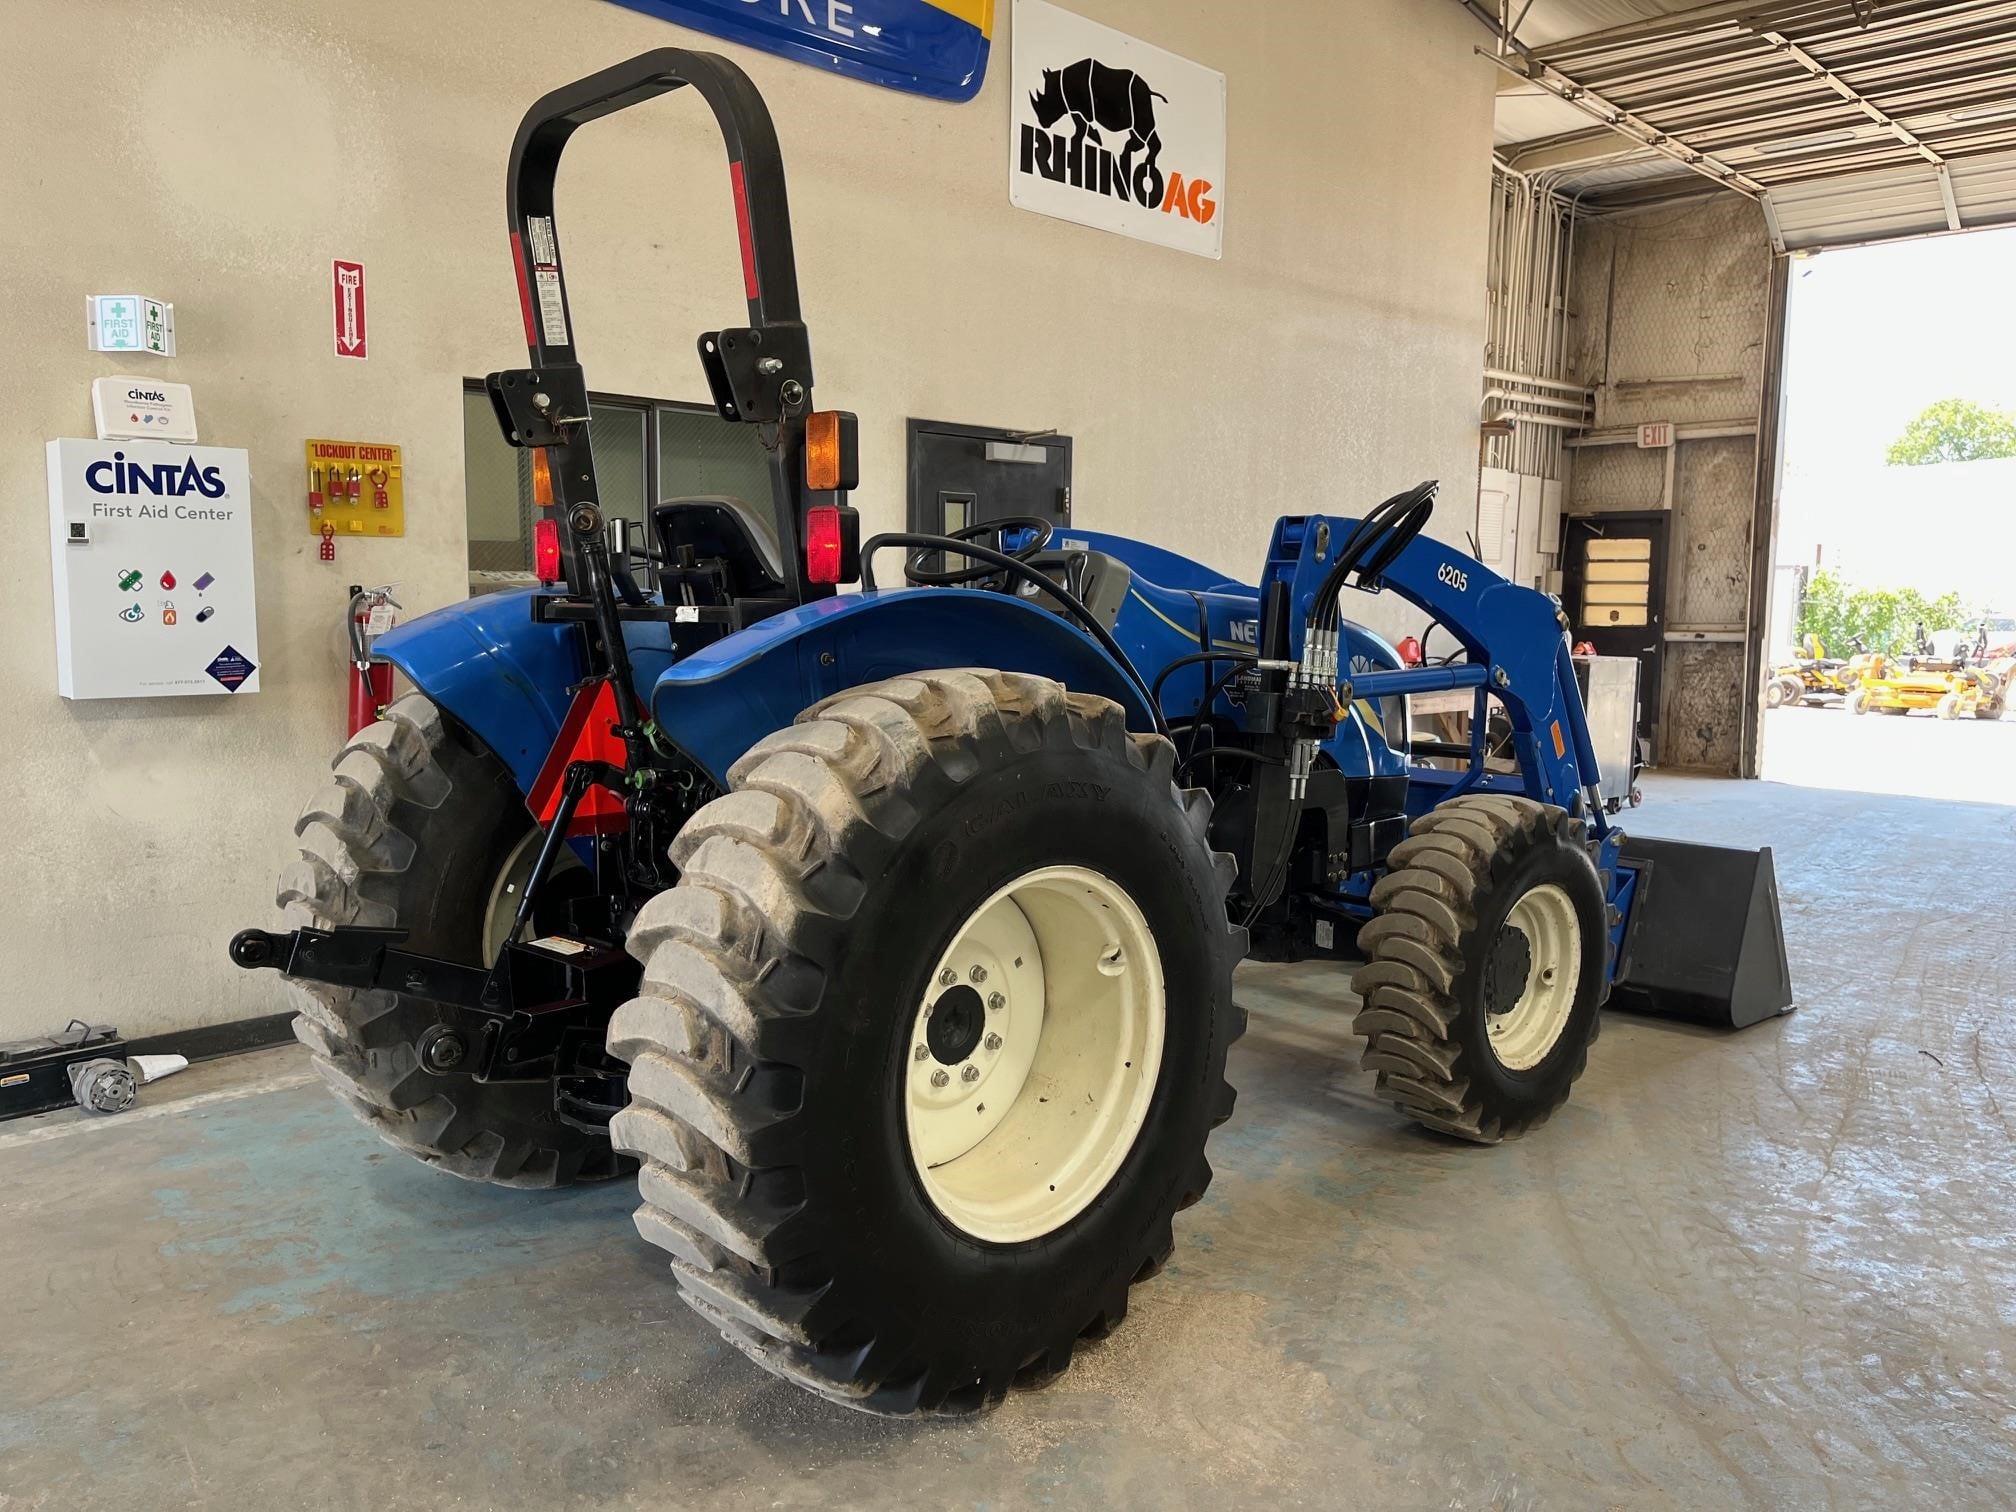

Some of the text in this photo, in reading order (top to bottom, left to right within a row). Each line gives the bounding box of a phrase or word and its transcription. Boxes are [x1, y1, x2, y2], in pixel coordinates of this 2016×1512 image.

[341, 274, 358, 285] FIRE
[104, 319, 133, 329] FIRST
[146, 320, 163, 333] FIRST
[111, 329, 129, 338] AID
[150, 331, 161, 342] AID
[1643, 424, 1669, 446] EXIT
[314, 443, 393, 462] LOCKOUT CENTER
[92, 503, 234, 521] First Aid Center
[1437, 562, 1468, 592] 6205
[1230, 620, 1258, 644] NE
